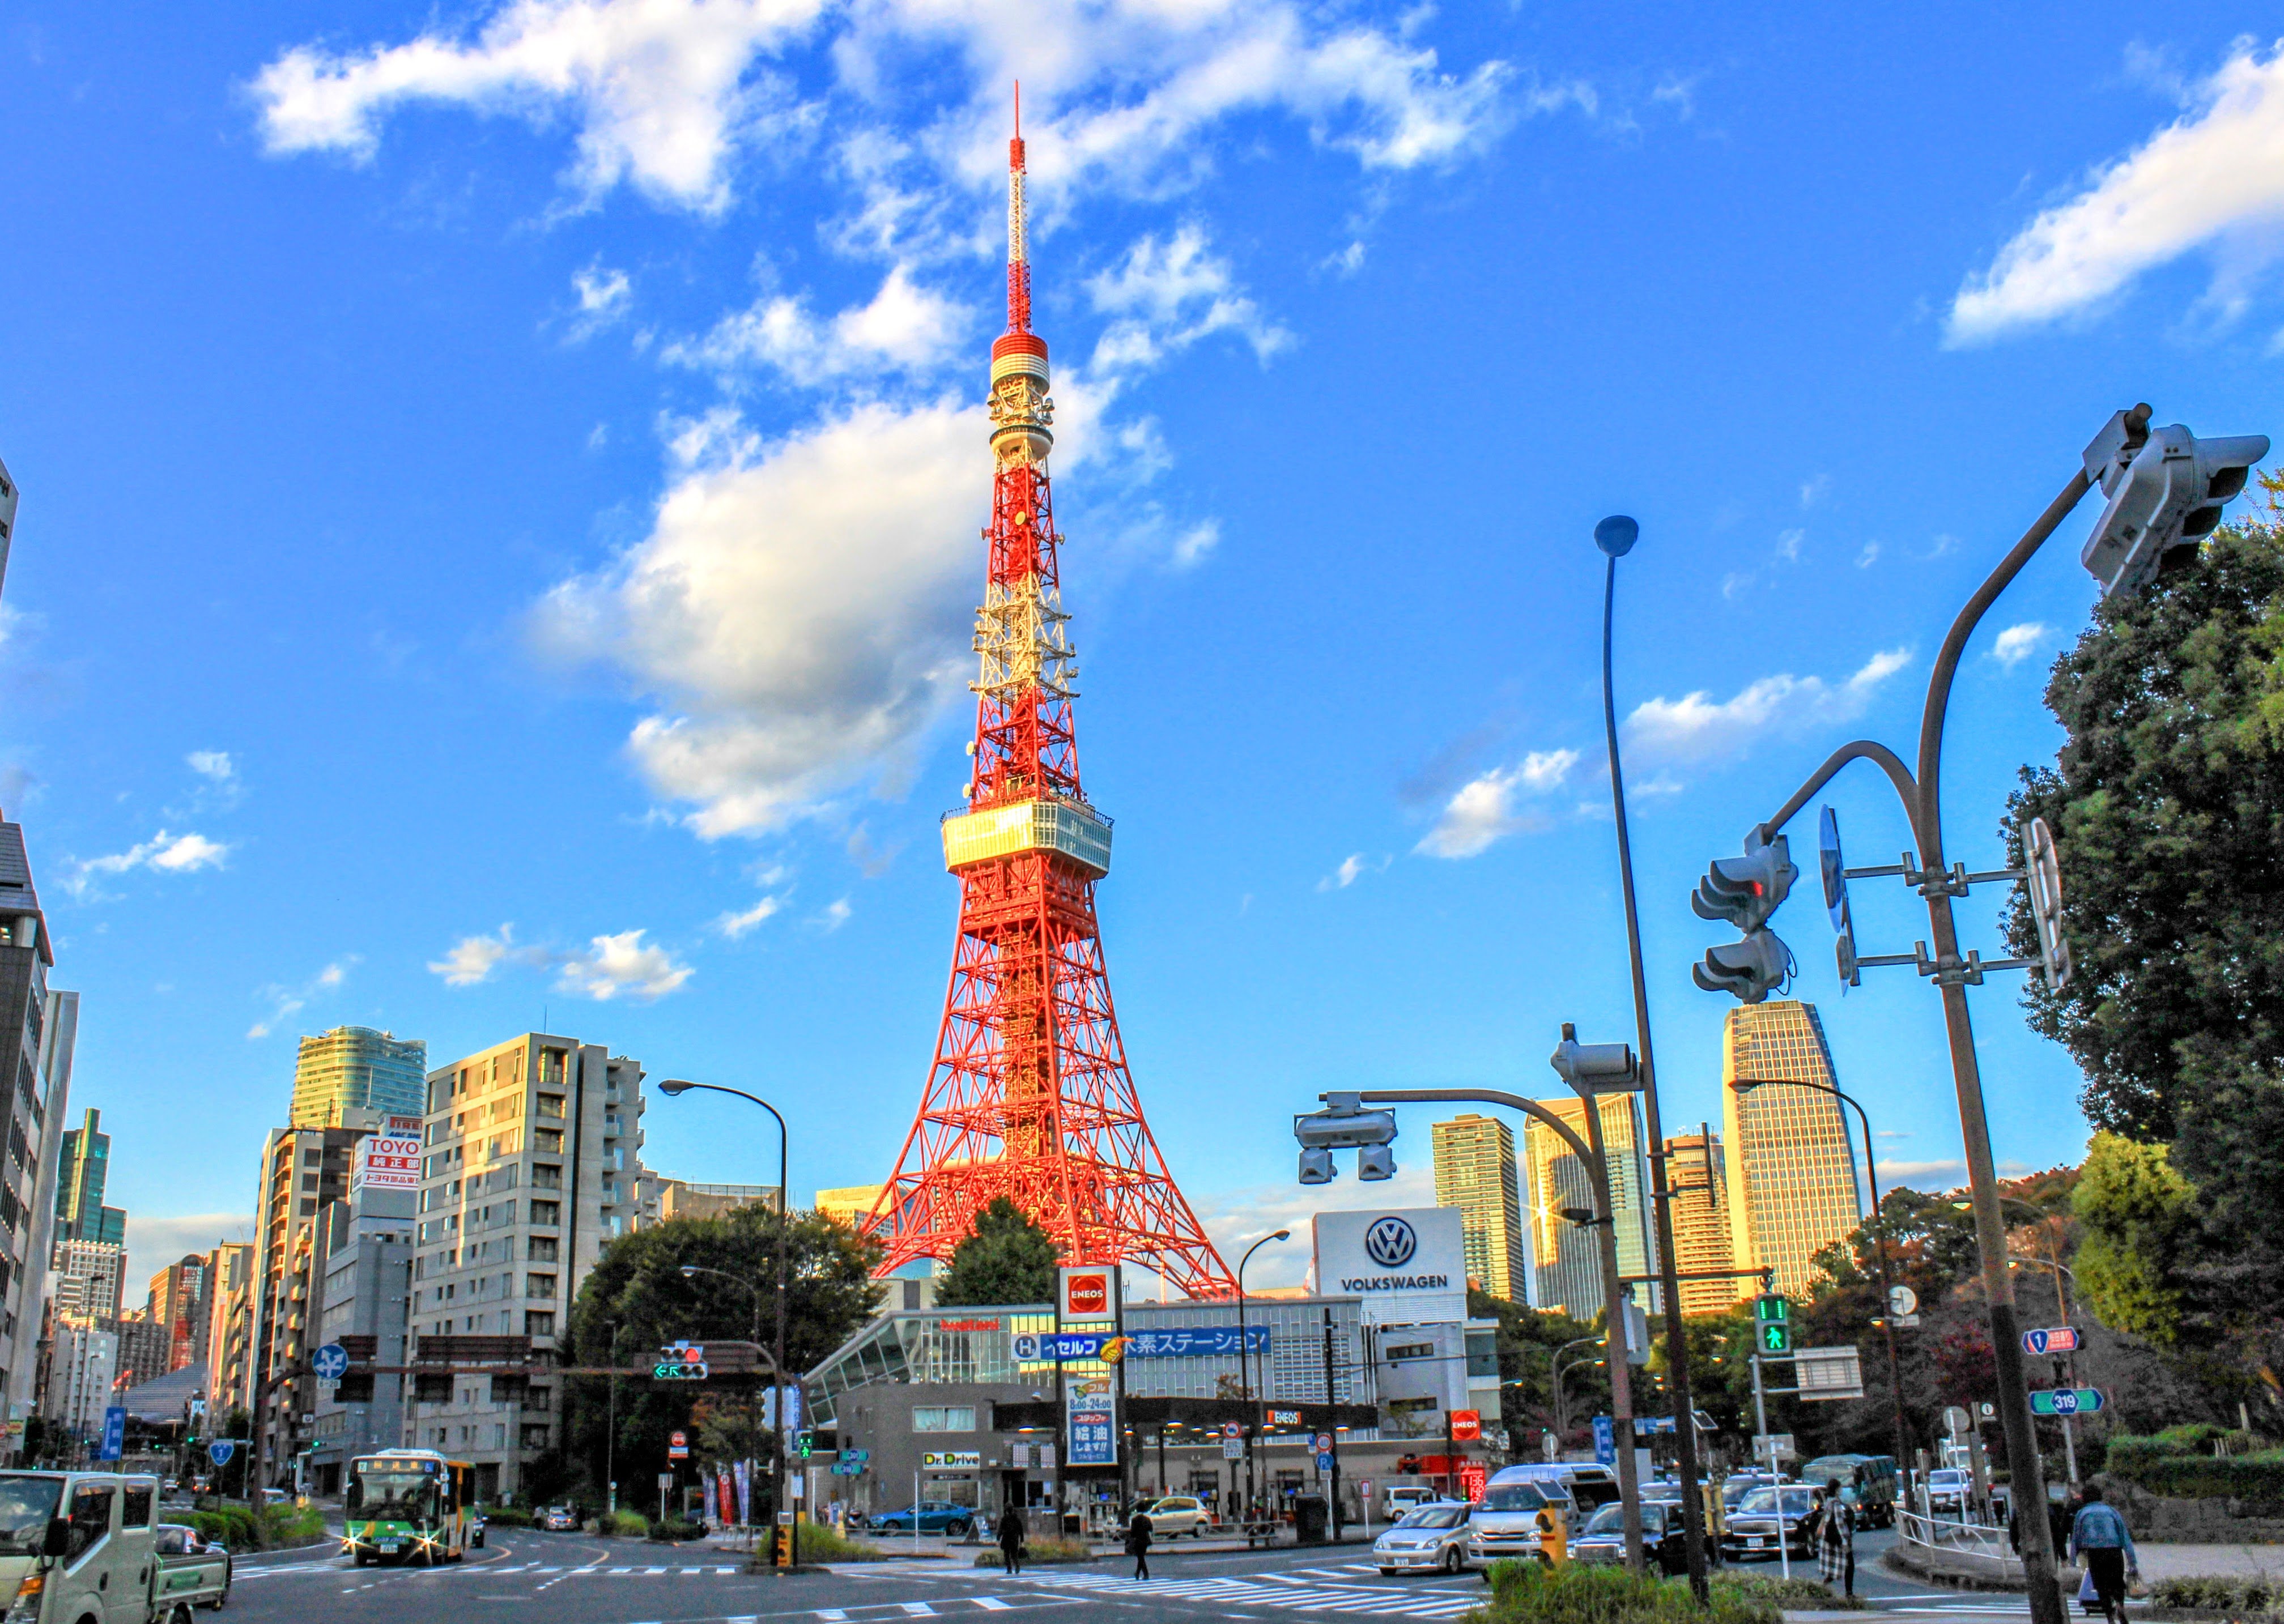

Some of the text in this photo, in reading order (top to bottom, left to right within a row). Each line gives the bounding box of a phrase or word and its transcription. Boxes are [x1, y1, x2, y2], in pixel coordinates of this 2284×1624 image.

[369, 1139, 421, 1154] TOYO
[1341, 1275, 1448, 1291] VOLKSWAGEN
[1071, 1289, 1103, 1299] ENEOS
[2035, 1333, 2042, 1348] 1
[1057, 1340, 1097, 1356] セルフ
[1088, 1383, 1106, 1392] フル
[2055, 1395, 2075, 1409] 319
[1275, 1412, 1298, 1424] ENEOS
[1075, 1425, 1108, 1440] 給油
[925, 1453, 979, 1465] Dr. Drive
[1469, 1475, 1484, 1486] 136
